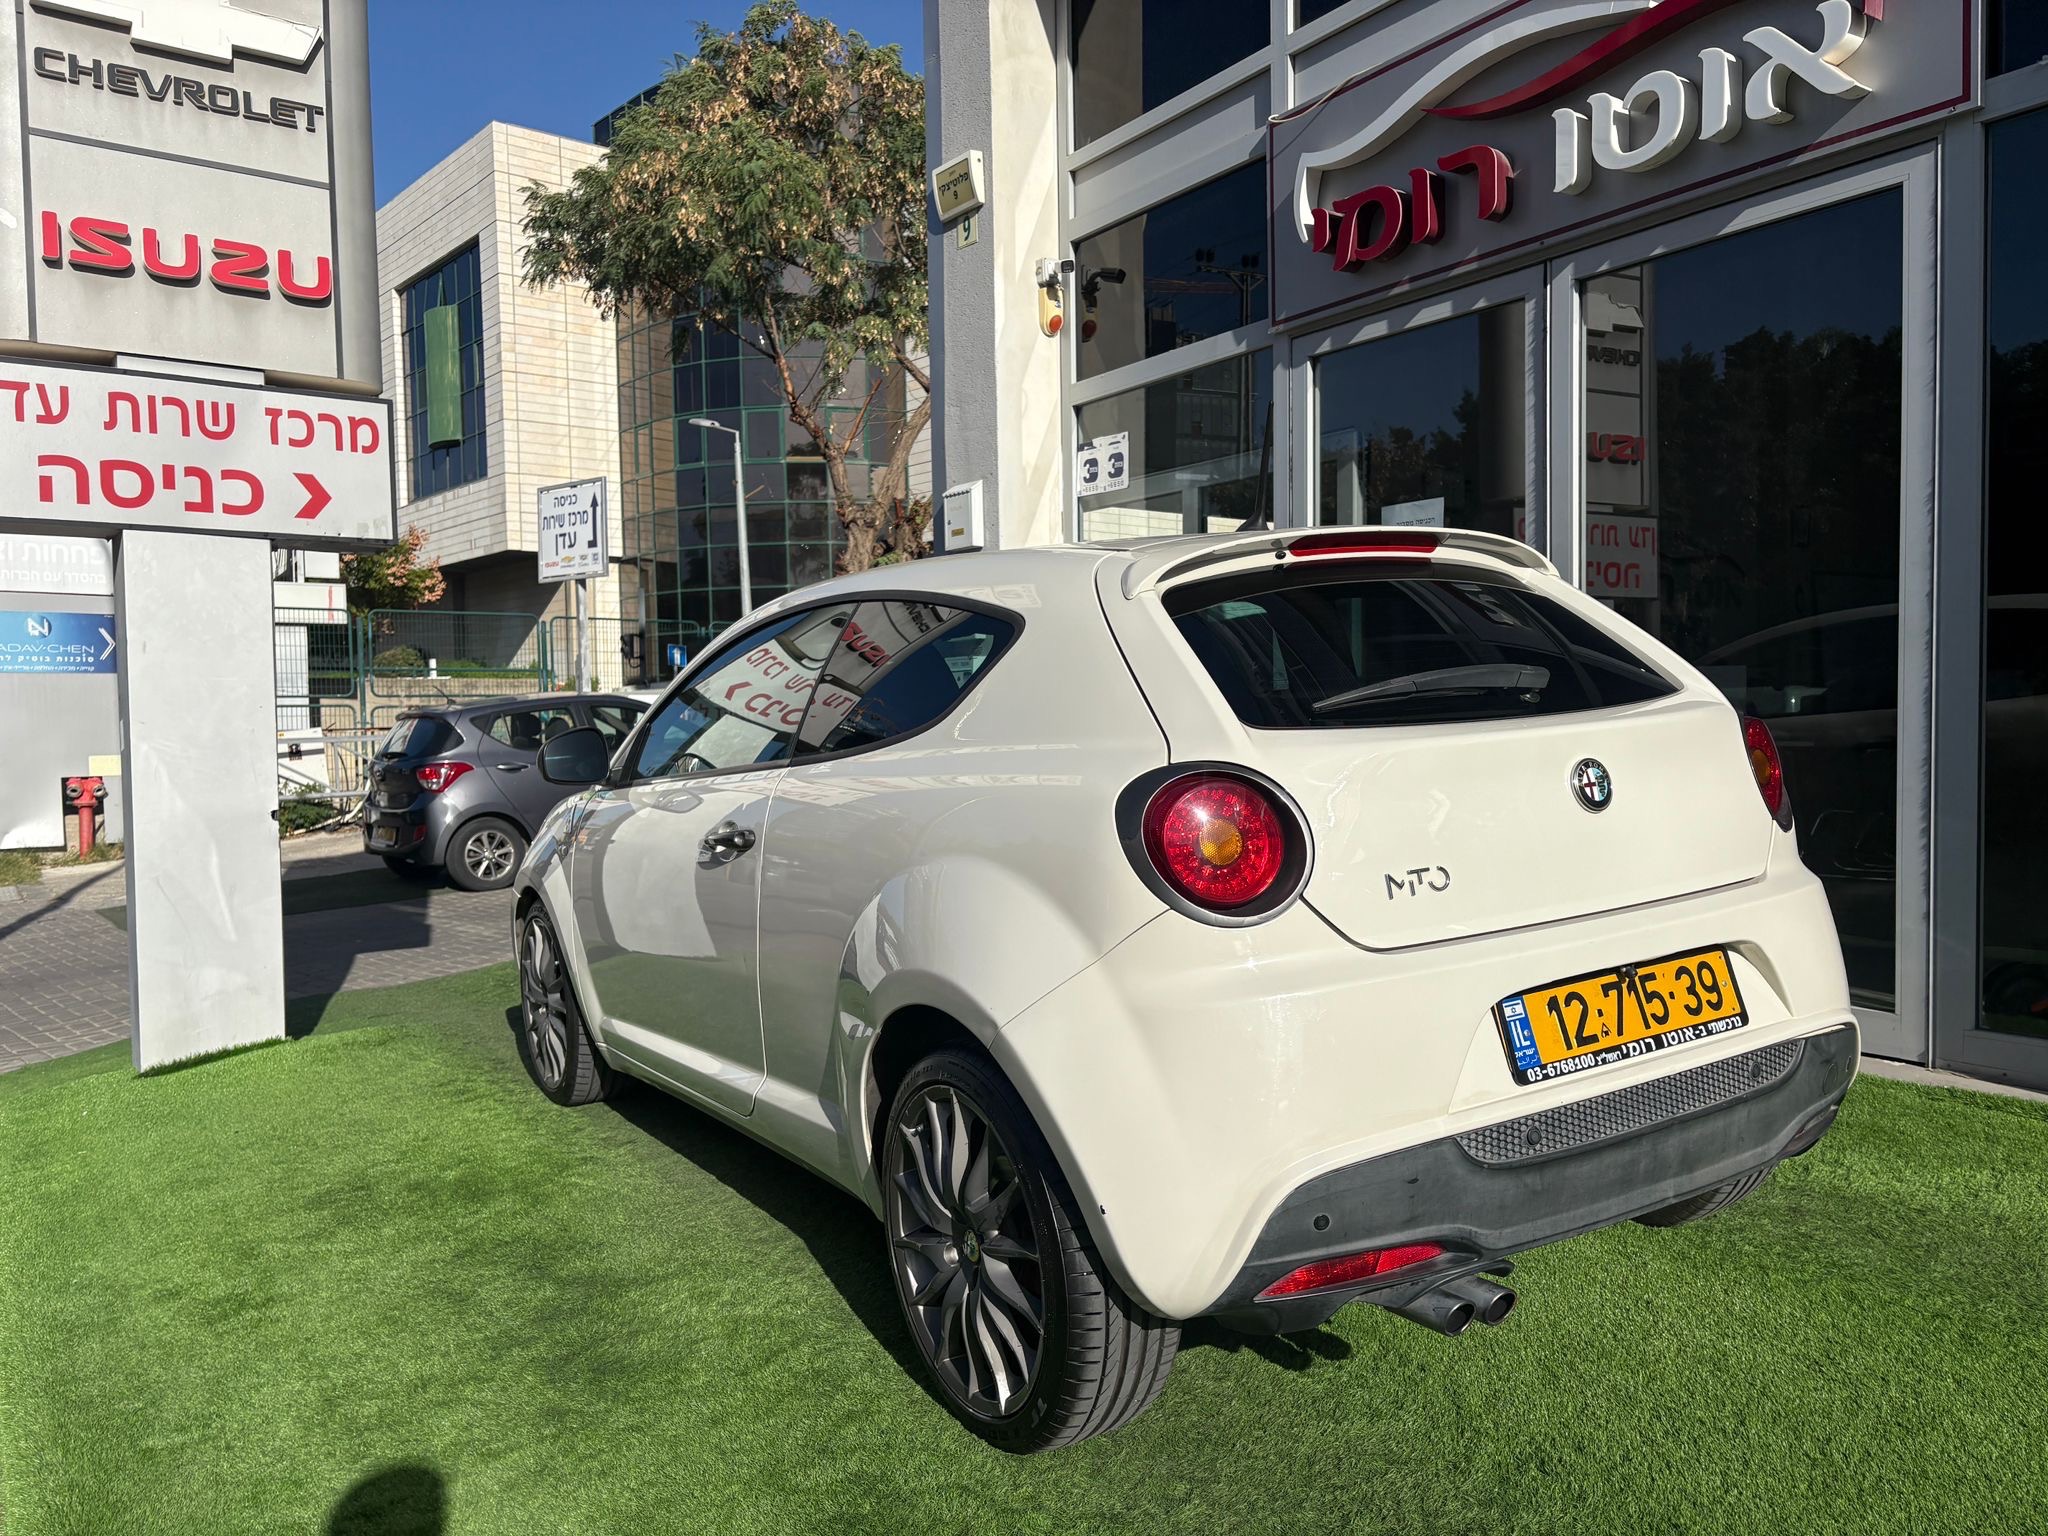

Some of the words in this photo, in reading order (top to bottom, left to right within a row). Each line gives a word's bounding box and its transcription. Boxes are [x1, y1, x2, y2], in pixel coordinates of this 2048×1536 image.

[33, 46, 325, 132] CHEVROLET
[1552, 0, 1872, 195] אוטו
[1312, 144, 1514, 272] רומי
[41, 210, 332, 303] ISUZU
[103, 390, 237, 440] שרות
[264, 407, 380, 455] מרכז
[37, 454, 265, 516] כניסה
[553, 493, 578, 508] כניסה
[542, 513, 566, 531] שירות
[568, 510, 589, 526] מרכז
[555, 531, 577, 556] עדן
[1511, 1020, 1531, 1048] IL
[1708, 1016, 1743, 1034] נרכשתי
[1515, 1047, 1536, 1058] ישראל
[1621, 1037, 1656, 1057] רומי
[1527, 1053, 1596, 1082] 03-6768100
